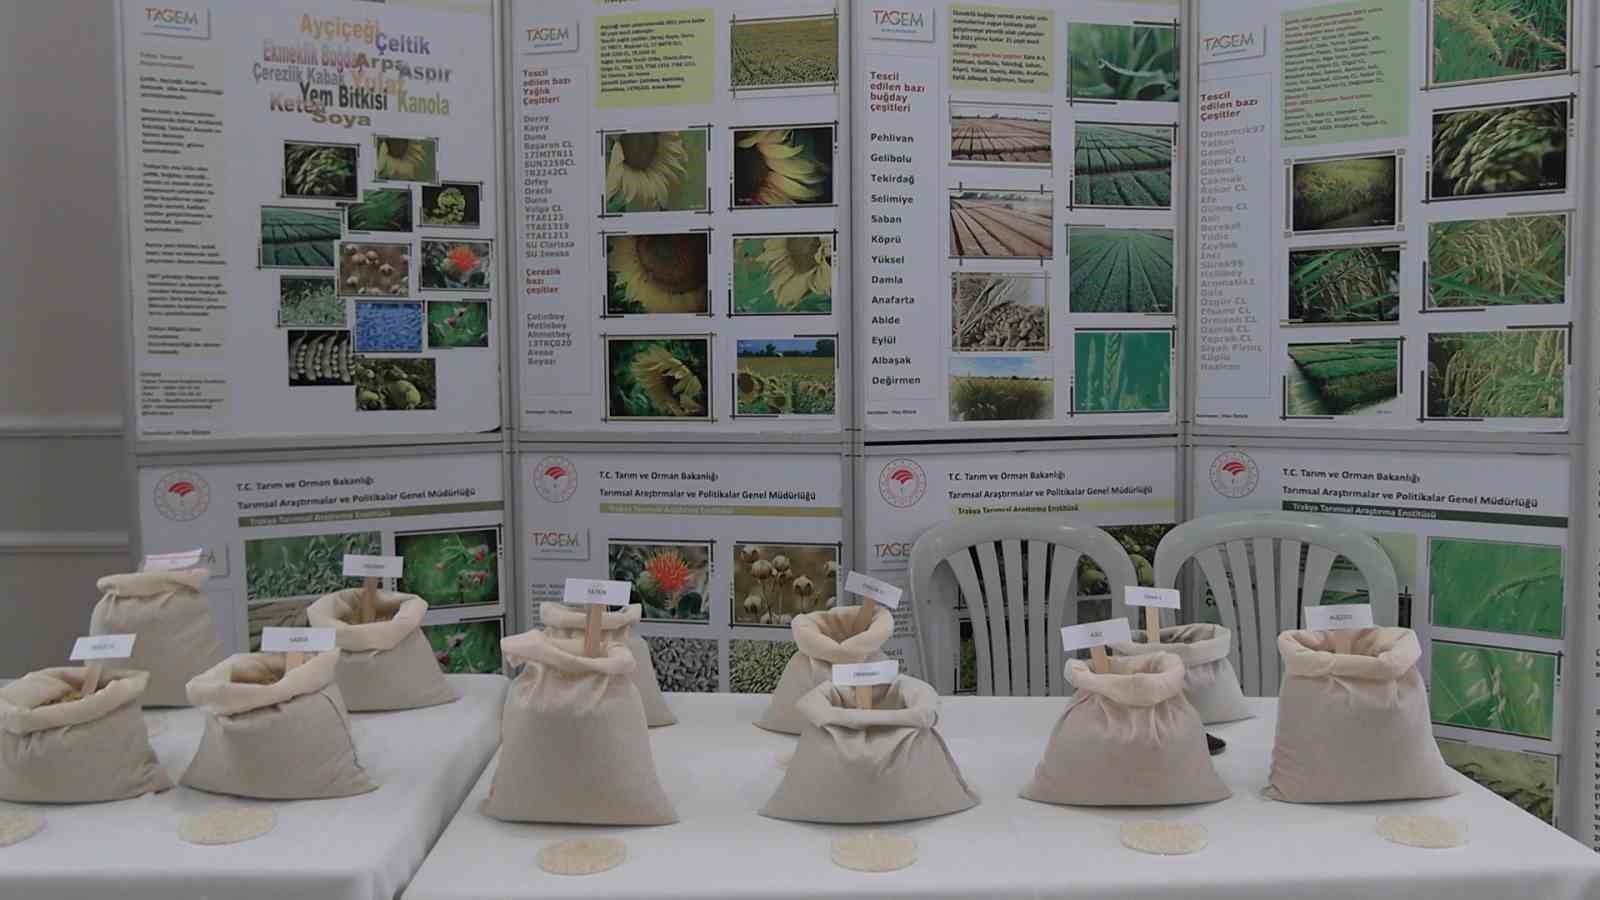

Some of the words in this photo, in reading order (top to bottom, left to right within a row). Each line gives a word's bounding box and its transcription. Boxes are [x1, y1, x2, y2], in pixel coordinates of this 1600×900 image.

[144, 7, 199, 25] TAGEM
[871, 9, 925, 28] TAGEM
[525, 26, 570, 41] TAGEM
[375, 33, 432, 55] Çeltik
[1202, 32, 1256, 51] TAGEM
[870, 71, 900, 81] Tescil
[869, 81, 902, 92] edilen
[299, 81, 334, 110] Yem
[339, 84, 389, 113] Bitkisi
[869, 91, 909, 103] buğday
[397, 91, 451, 117] Kanola
[311, 110, 373, 129] Soya
[870, 132, 916, 143] Pehlivan
[870, 153, 913, 163] Gelibolu
[871, 173, 916, 185] Tekirdağ
[871, 194, 915, 205] Selimiye
[871, 214, 903, 224] Saban
[871, 234, 903, 245] Köprü
[871, 254, 906, 264] Yüksel
[871, 275, 904, 284] Damla
[871, 295, 916, 305] Anafarta
[871, 315, 901, 325] Abide
[871, 335, 897, 346] Eylül
[871, 355, 912, 366] Albaşak
[872, 375, 922, 386] Değirmen
[599, 470, 613, 480] T.C.
[615, 471, 638, 480] Tarım
[640, 472, 650, 480] ve
[651, 471, 679, 480] Orman
[948, 472, 962, 481] T.C.
[965, 472, 988, 481] Tarım
[989, 473, 999, 481] ve
[1000, 471, 1029, 480] Orman
[1282, 467, 1298, 478] T.C.
[1301, 469, 1327, 479] Tarım
[1328, 471, 1340, 480] ve
[1341, 470, 1375, 481] Orman
[236, 482, 252, 491] T.C.
[256, 480, 283, 490] Tarım
[285, 480, 296, 489] ve
[298, 478, 331, 487] Orman
[236, 501, 278, 510] Tarımsal
[280, 496, 338, 507] Araştırmalar
[340, 495, 350, 503] ve
[352, 492, 398, 504] Politikalar
[399, 490, 426, 500] Genel
[599, 488, 633, 498] Tarımsal
[634, 489, 684, 500] Araştırmalar
[698, 490, 741, 500] Politikalar
[741, 490, 768, 500] Genel
[948, 490, 983, 500] Tarımsal
[984, 488, 1033, 501] Araştırmalar
[1046, 488, 1086, 498] Politikalar
[1087, 487, 1110, 496] Genel
[1282, 486, 1321, 496] Tarımsal
[1322, 487, 1380, 500] Araştırmalar
[1382, 492, 1394, 500] ve
[1396, 491, 1446, 503] Politikalar
[1448, 494, 1479, 504] Genel
[532, 532, 579, 547] TAGEM
